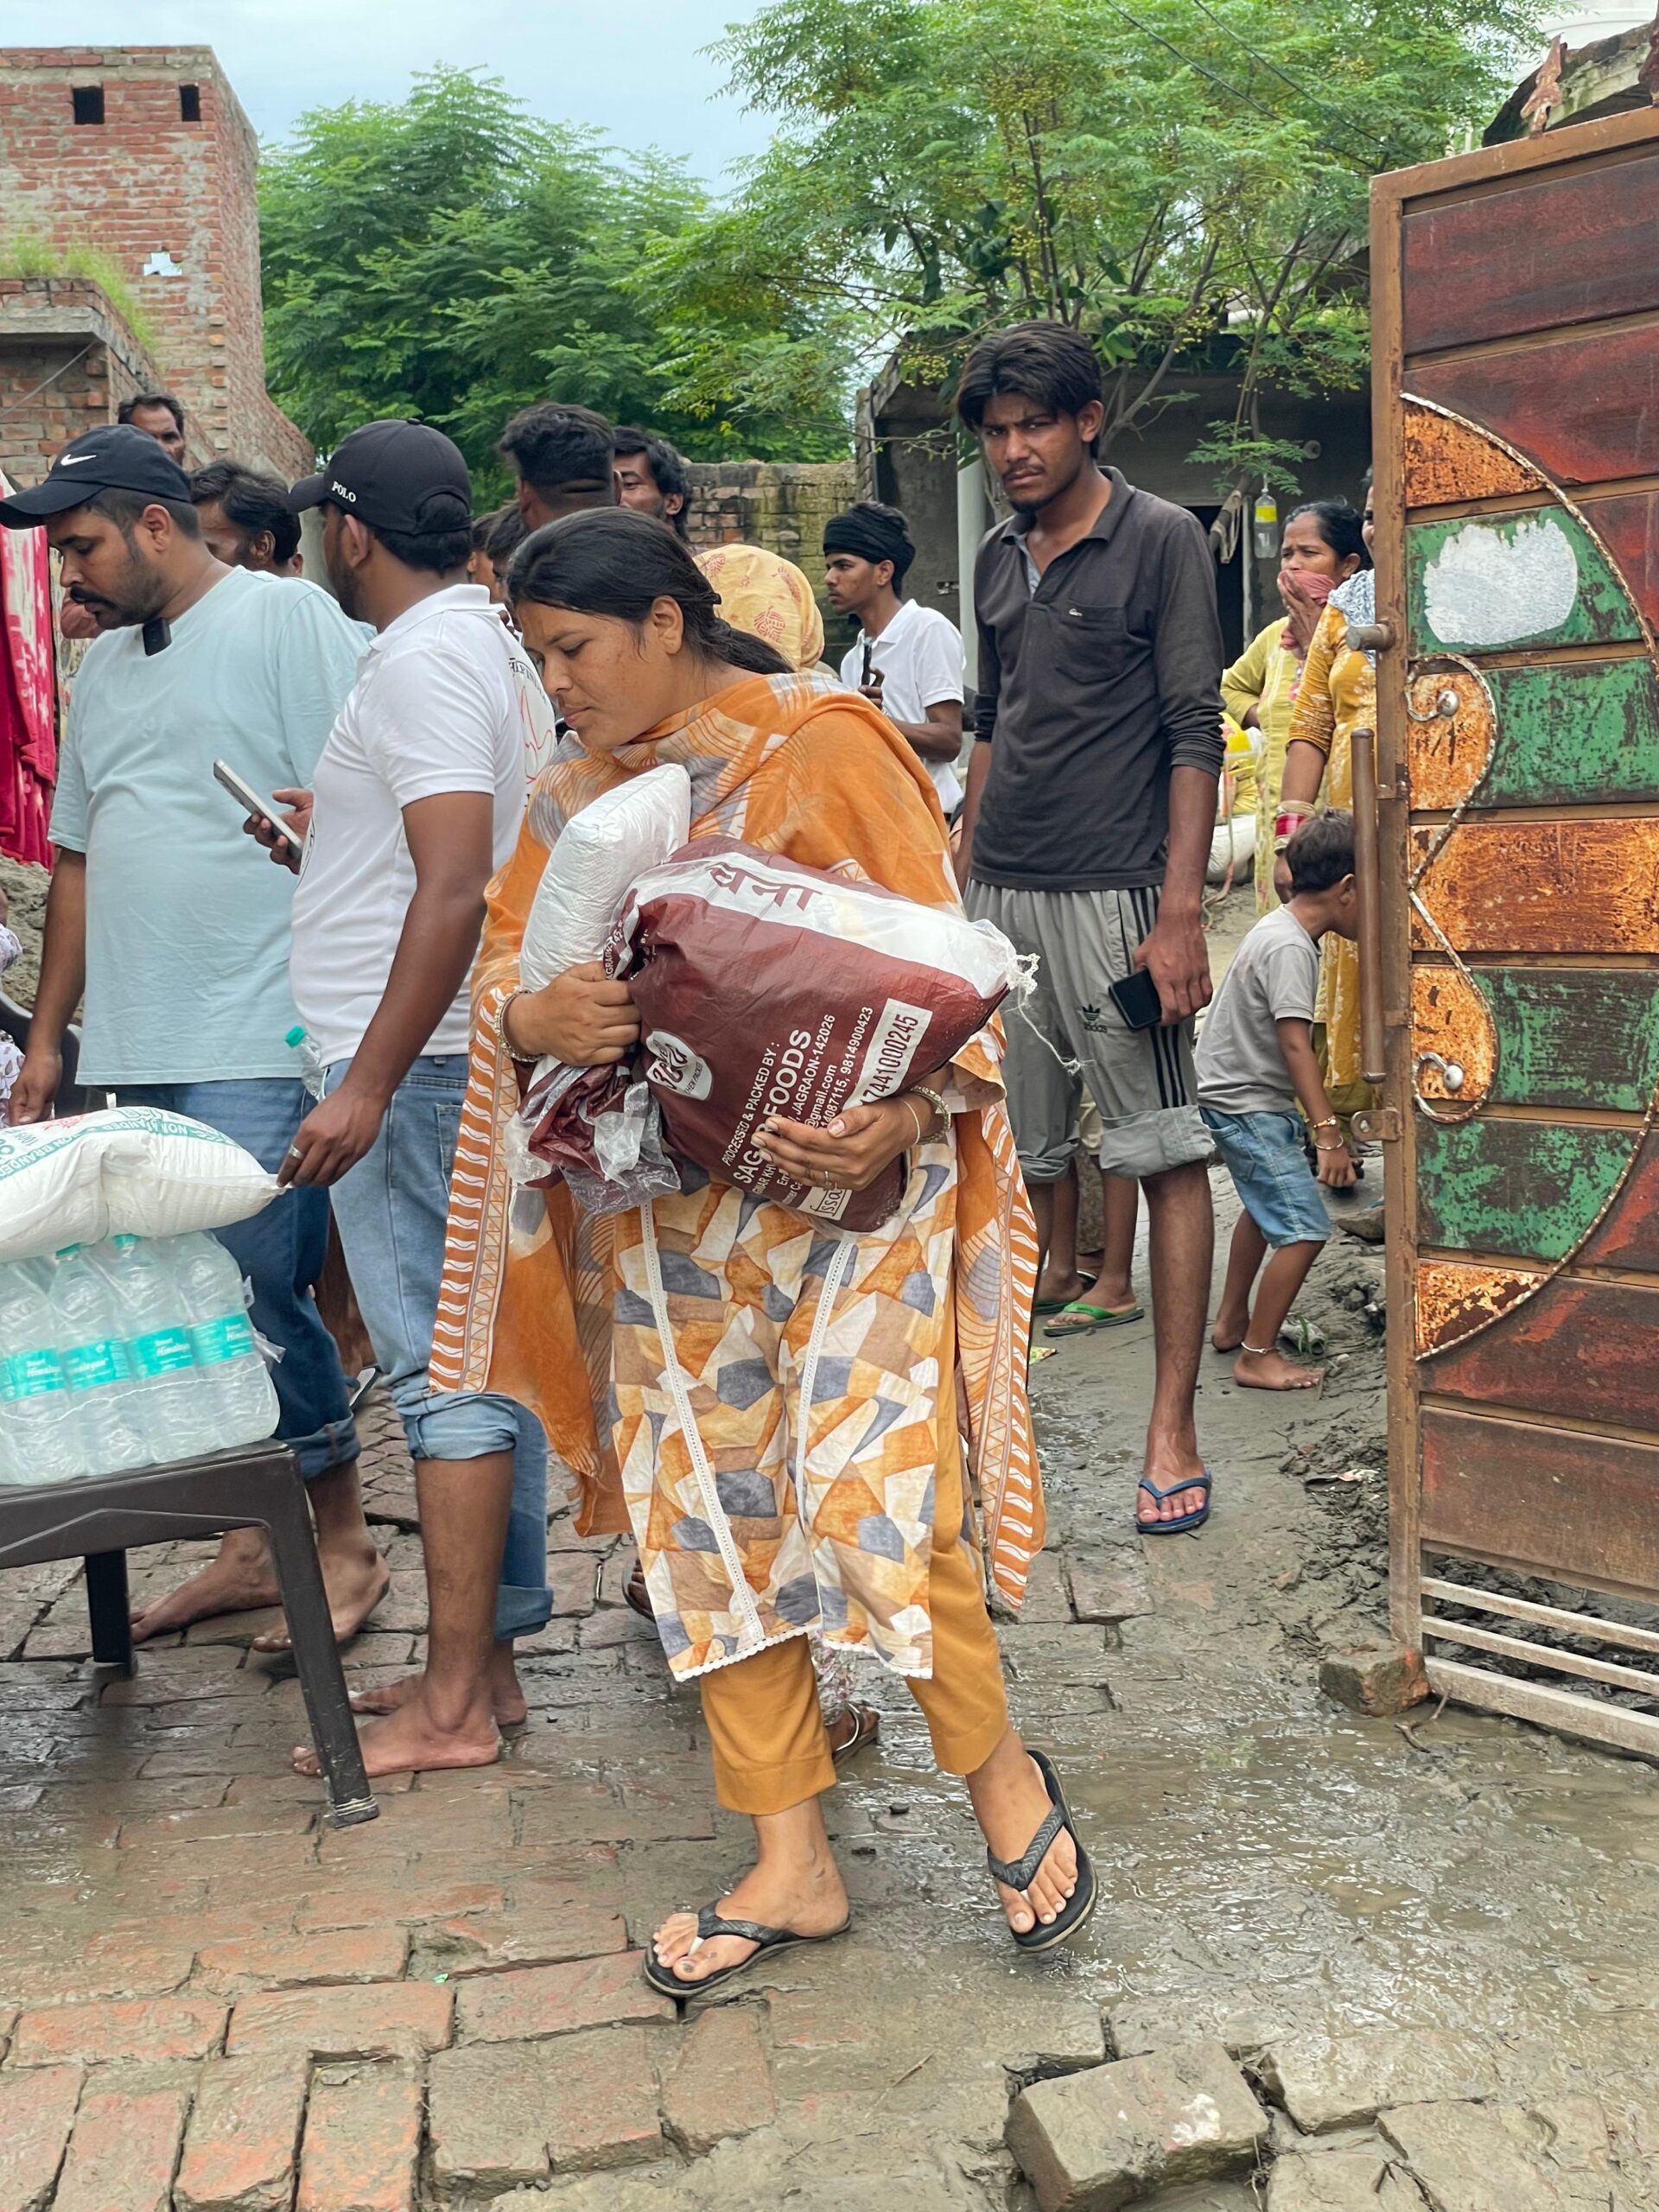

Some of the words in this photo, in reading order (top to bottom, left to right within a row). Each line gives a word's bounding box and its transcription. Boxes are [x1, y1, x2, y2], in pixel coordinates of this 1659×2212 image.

[332, 480, 357, 503] POLO
[705, 861, 823, 912] चना
[761, 1047, 777, 1067] BY
[763, 1030, 811, 1118] FOODS
[791, 1014, 836, 1116] JAGRAON-142026
[820, 1077, 851, 1128] 14087115,
[840, 1006, 874, 1075] 9814900423
[745, 1067, 770, 1111] PACKED
[804, 1064, 837, 1128] @gmail.com
[741, 1113, 754, 1122] &
[721, 1121, 750, 1166] PROCESSED
[810, 1188, 843, 1217] fssa
